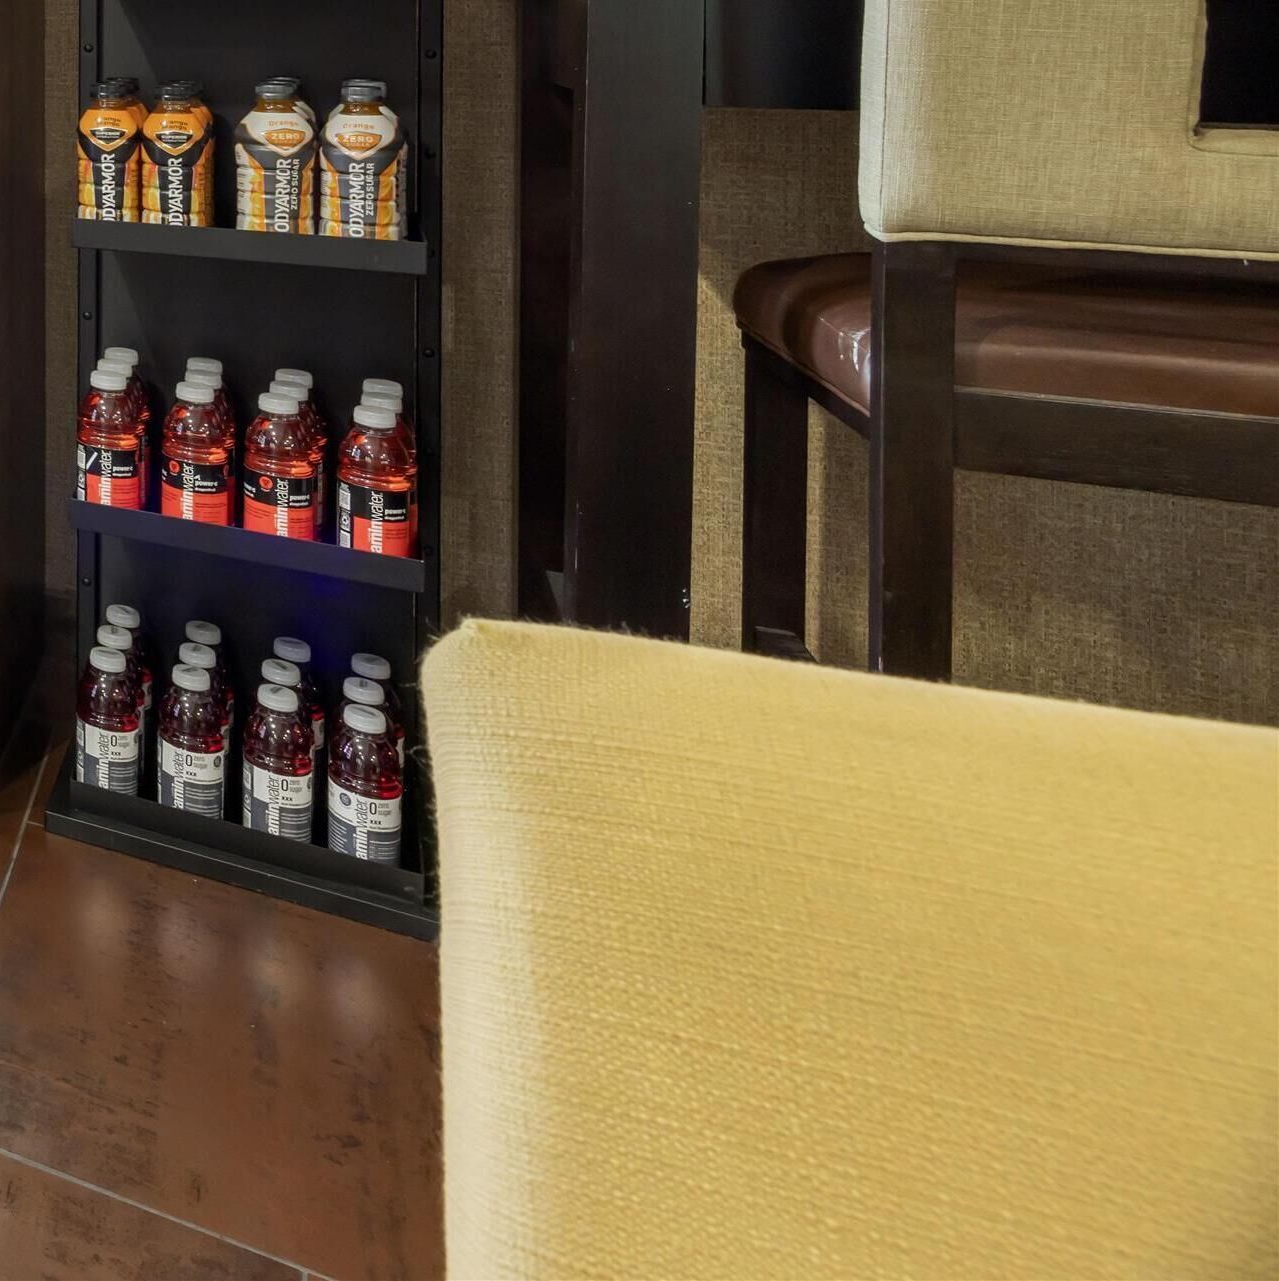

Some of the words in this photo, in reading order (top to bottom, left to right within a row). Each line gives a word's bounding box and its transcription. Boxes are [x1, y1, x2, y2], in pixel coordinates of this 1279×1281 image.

[271, 132, 300, 141] ZERO
[343, 134, 374, 144] ZERO
[102, 153, 116, 221] DYARMOR
[291, 158, 300, 188] SUGAR
[366, 162, 375, 193] SUGAR
[274, 158, 291, 233] ODYARMOR
[291, 190, 299, 210] ZERO
[349, 162, 364, 239] ODYARMOR
[366, 194, 374, 216] ZERO
